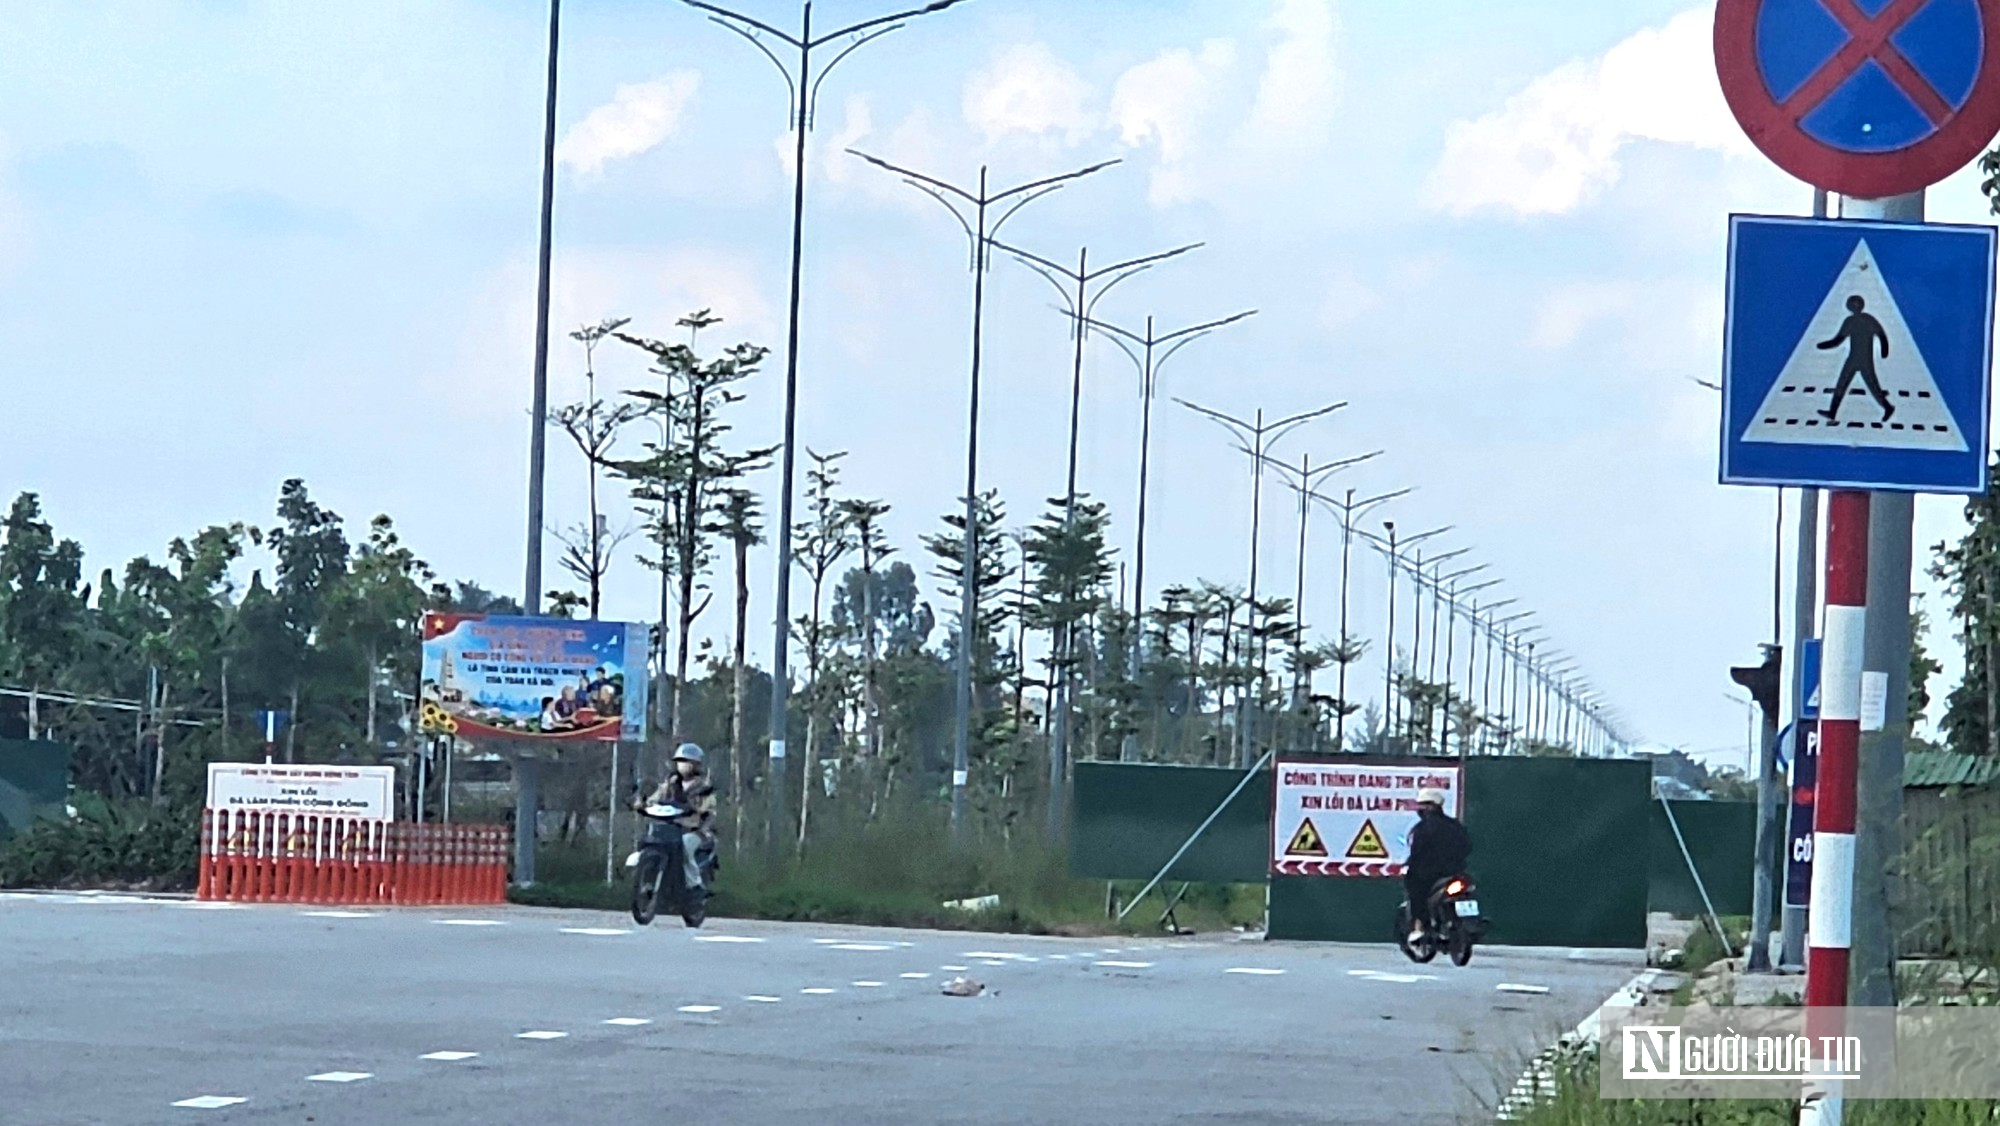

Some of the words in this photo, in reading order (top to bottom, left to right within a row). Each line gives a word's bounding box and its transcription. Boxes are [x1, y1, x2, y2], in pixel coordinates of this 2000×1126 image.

[1284, 769, 1317, 786] CÔNG
[1321, 770, 1356, 787] TRÌNH
[1359, 774, 1391, 788] ĐANG
[1395, 775, 1415, 788] THI
[1301, 796, 1322, 809] XIN
[1325, 792, 1344, 810] LỖI
[1347, 795, 1364, 811] ĐÃ
[1367, 796, 1392, 811] LÀM
